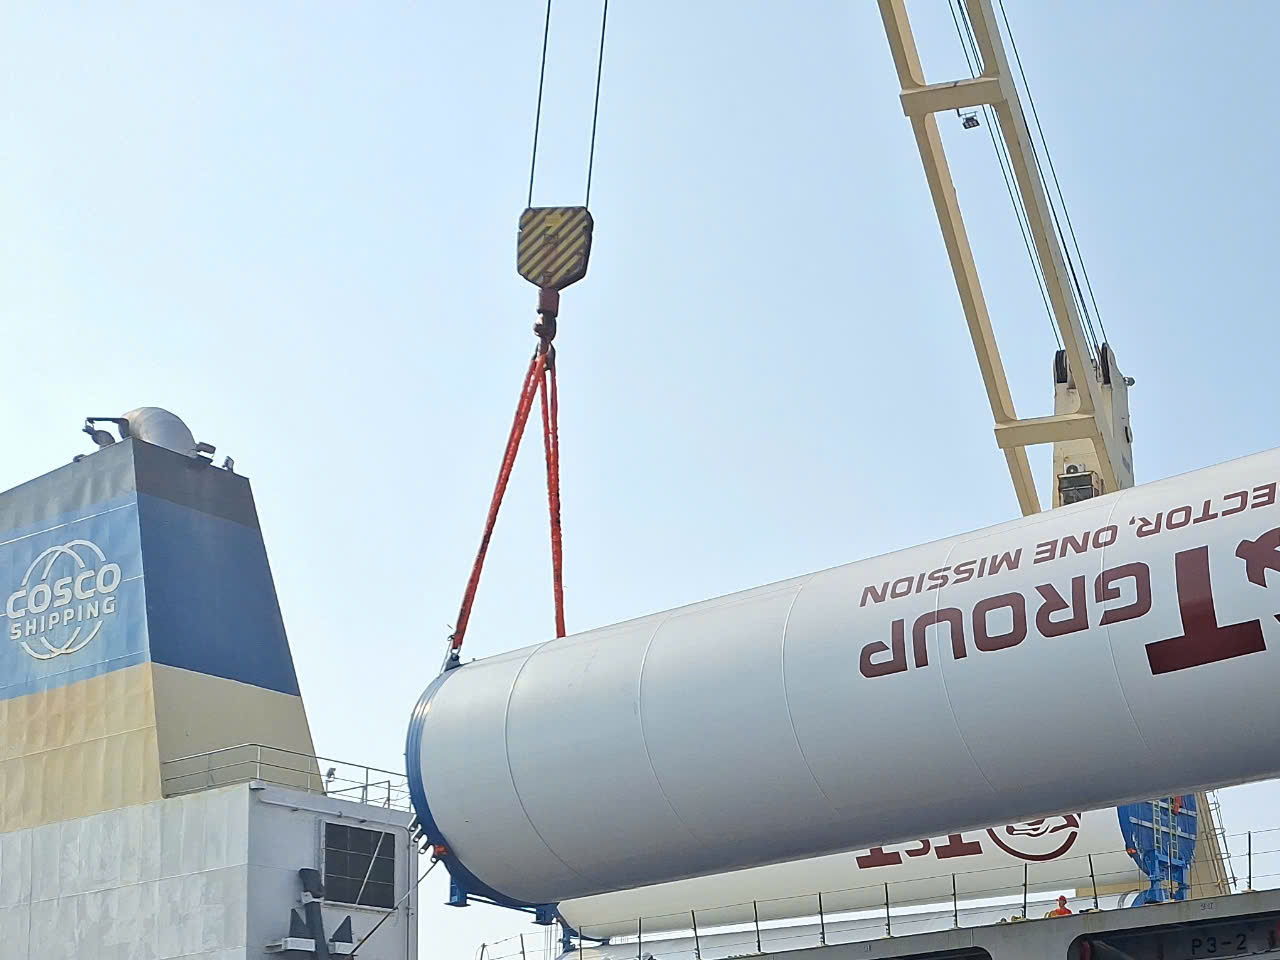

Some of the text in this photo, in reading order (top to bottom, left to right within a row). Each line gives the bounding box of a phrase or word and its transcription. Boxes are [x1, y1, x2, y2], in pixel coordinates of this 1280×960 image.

[1034, 524, 1118, 566] ONE
[6, 563, 122, 619] COSCO
[858, 548, 1022, 608] MISSION
[10, 596, 116, 641] SHIPPING
[858, 560, 1153, 679] GROUP
[1191, 933, 1247, 956] P3-2
